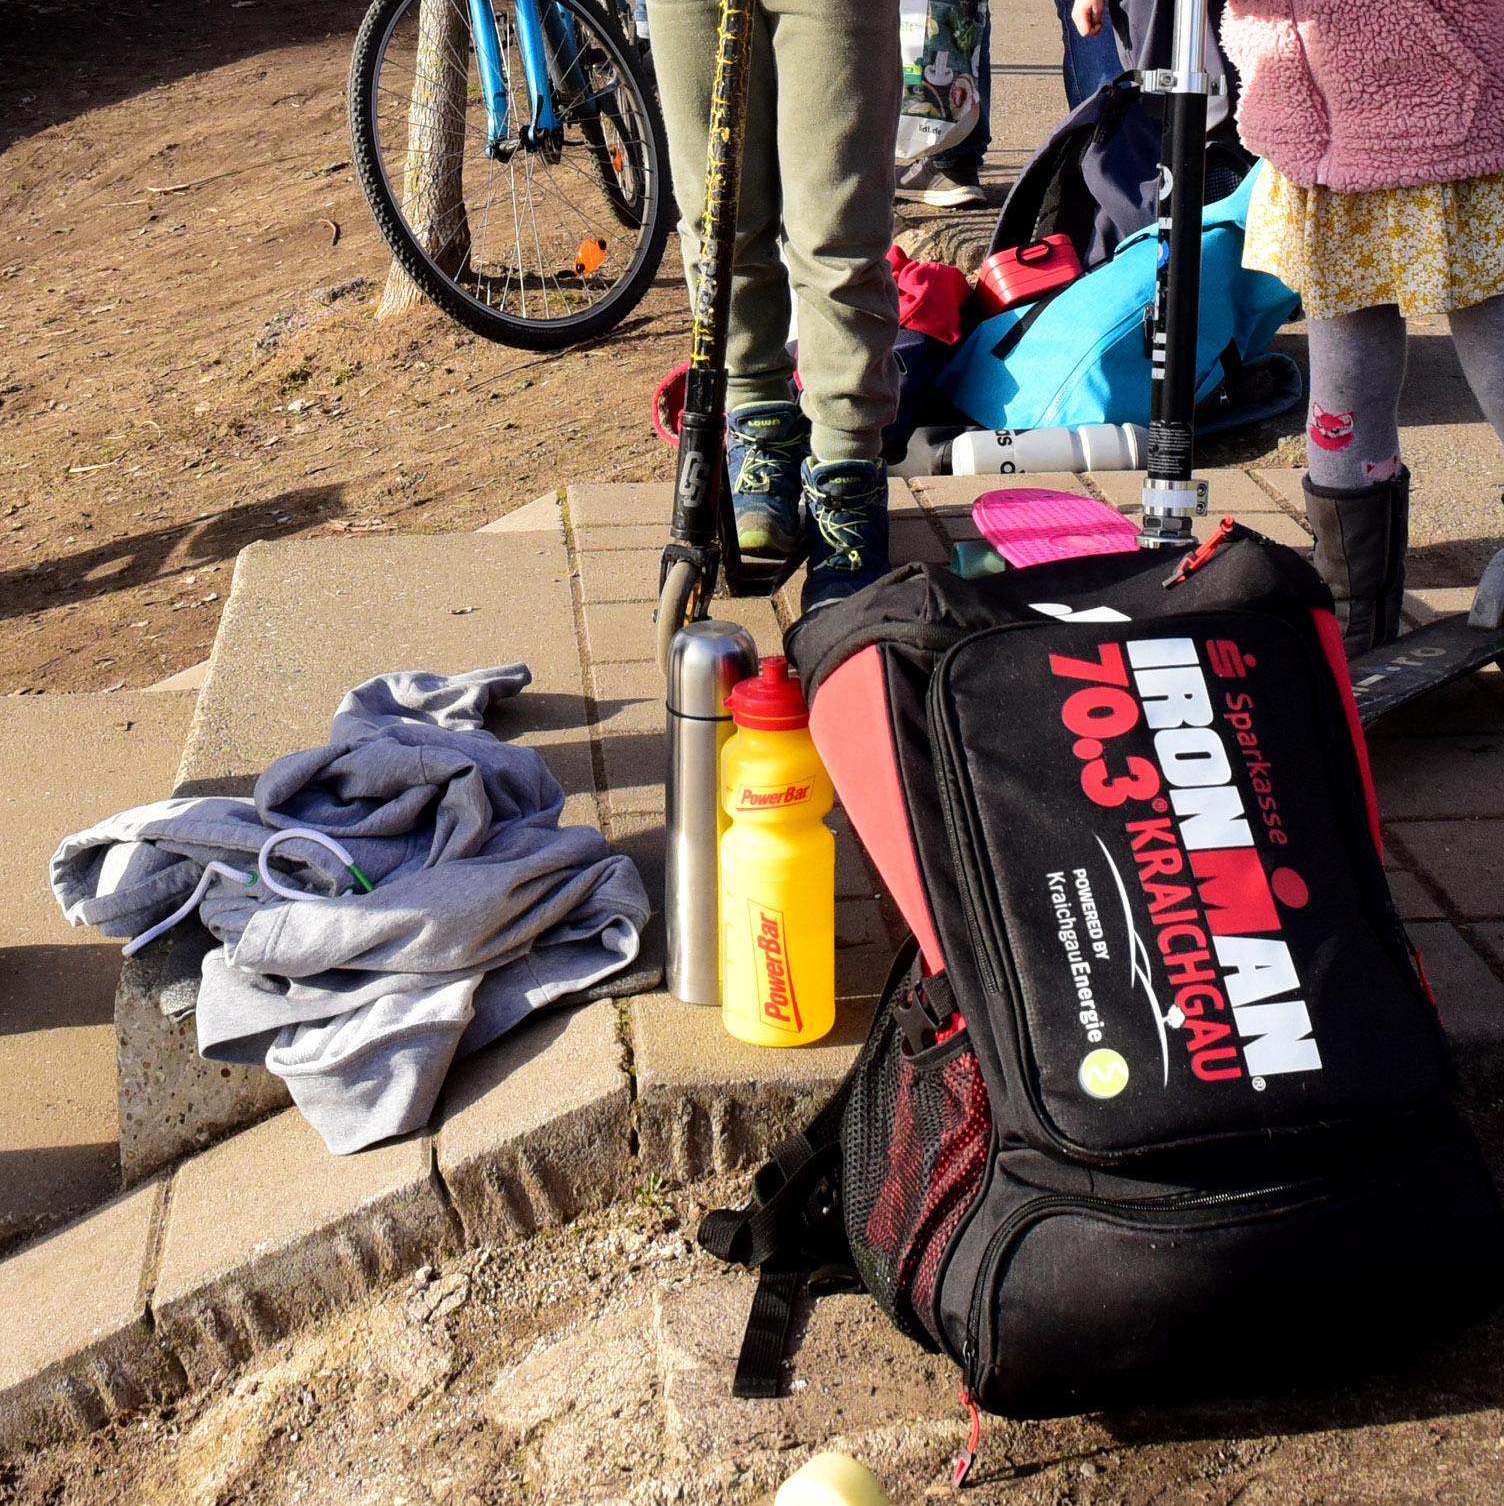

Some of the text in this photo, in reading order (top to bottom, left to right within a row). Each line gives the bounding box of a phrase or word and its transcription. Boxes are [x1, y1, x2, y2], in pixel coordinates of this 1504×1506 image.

[741, 786, 810, 805] PowerBar
[1224, 692, 1288, 846] Sparkasse
[1048, 642, 1242, 1083] 70.3 KRAICHGAU
[1074, 868, 1110, 960] POWERED BY
[1125, 637, 1323, 1077] IRONMAN
[757, 911, 791, 1023] PowerBar
[1046, 871, 1105, 1043] KraichgauEnergie
